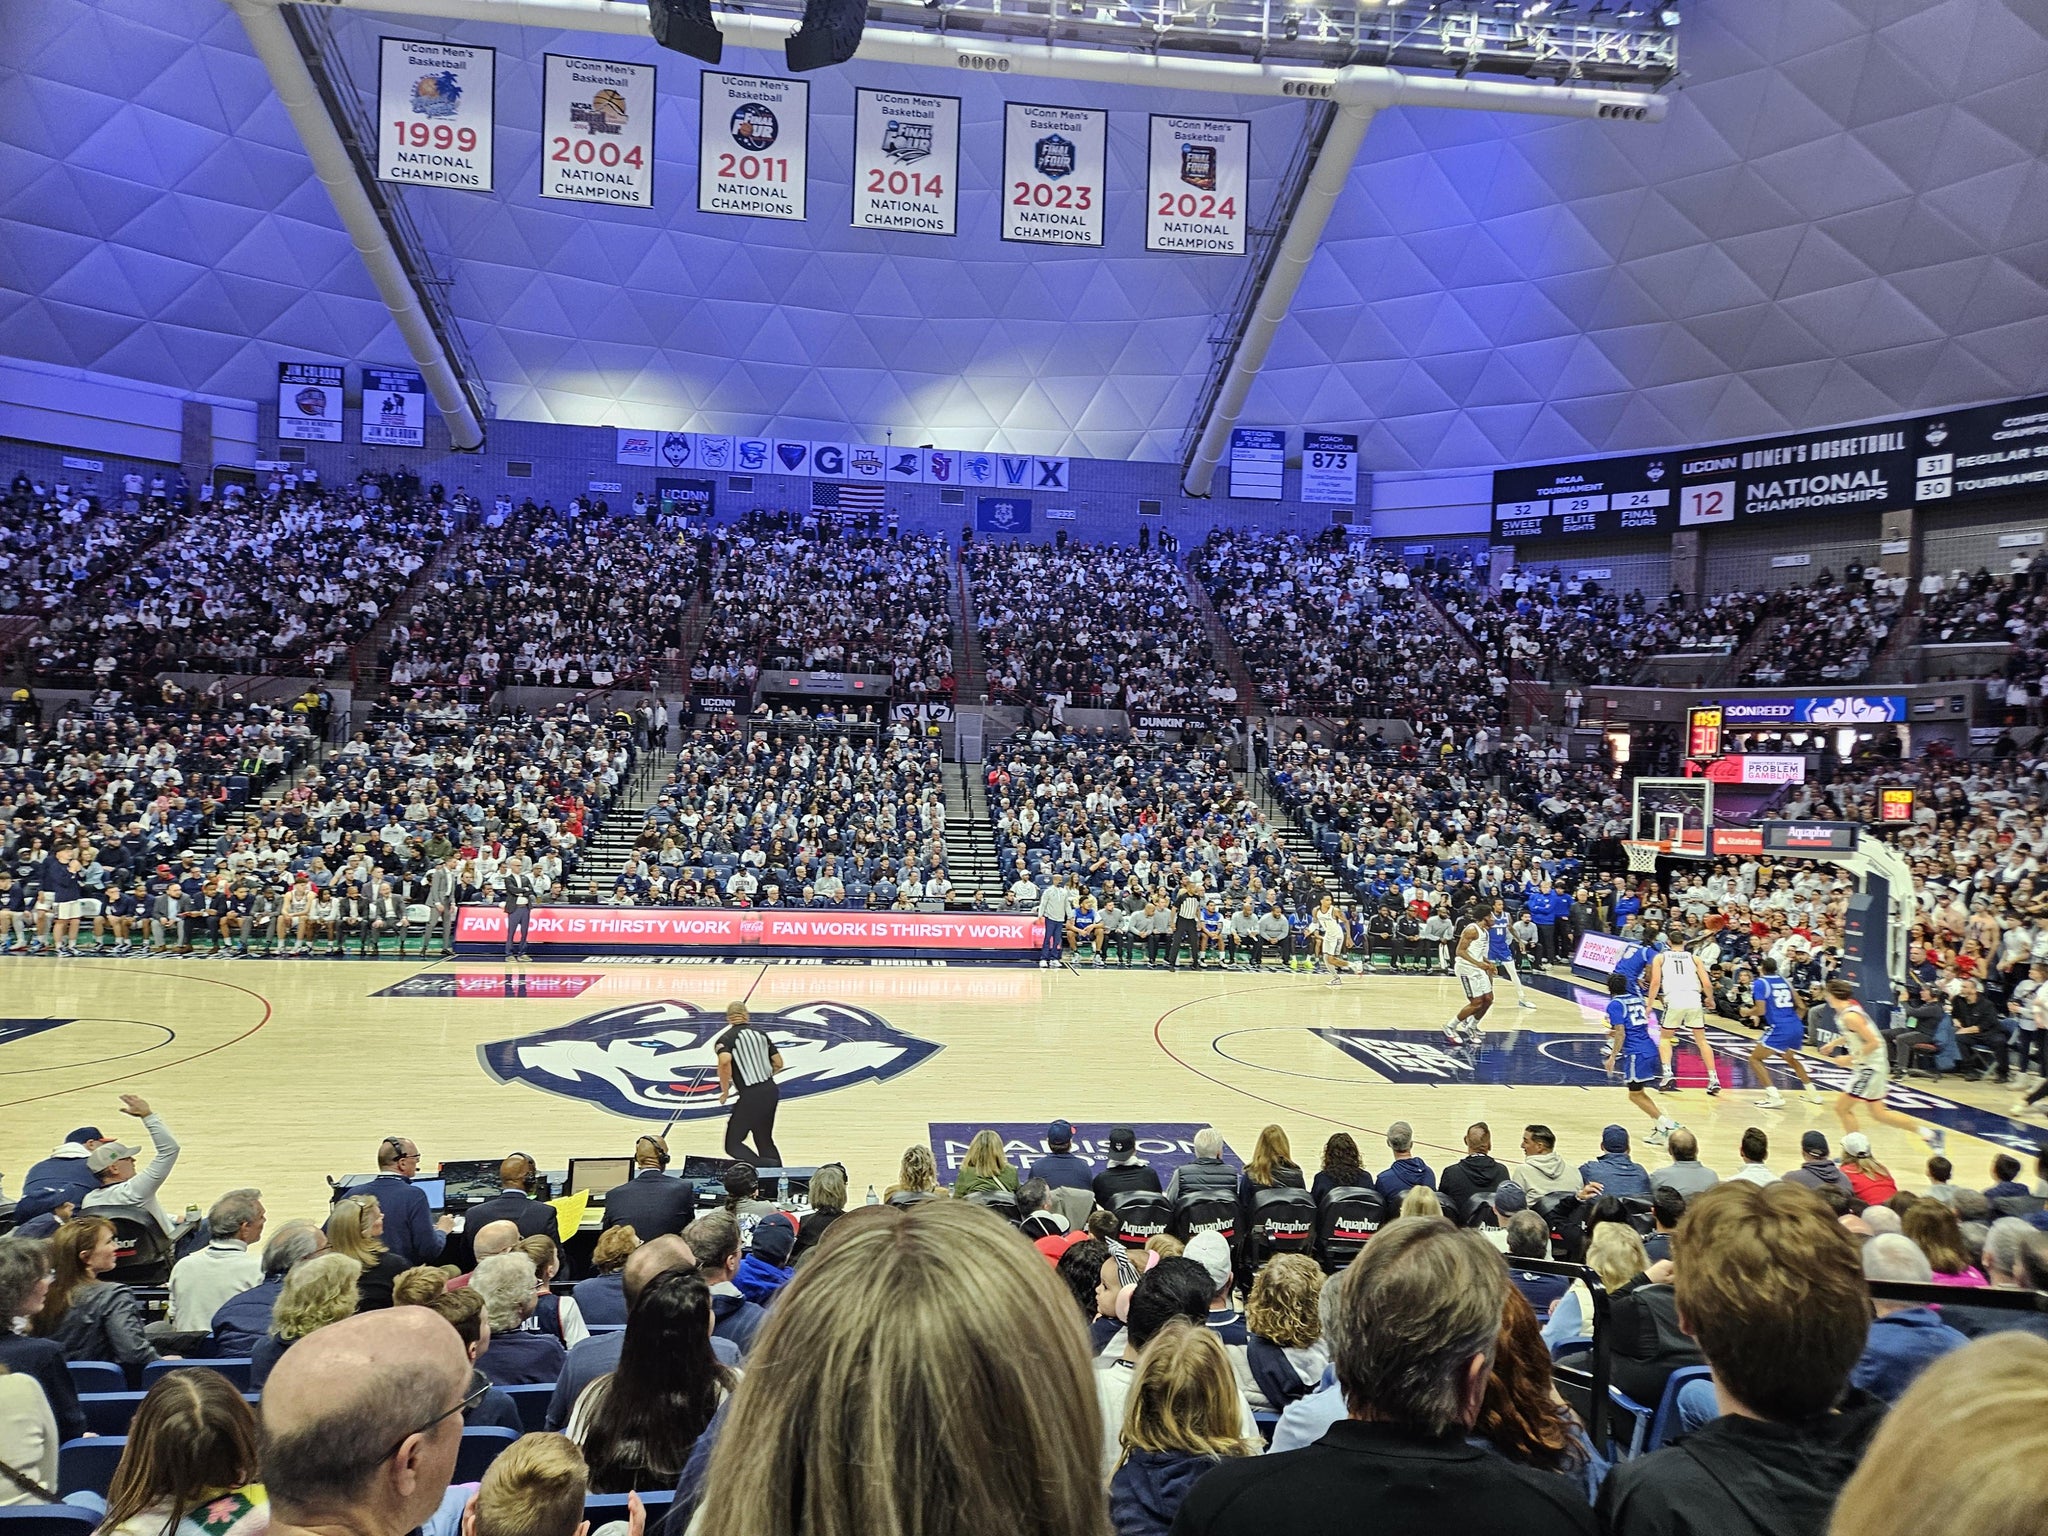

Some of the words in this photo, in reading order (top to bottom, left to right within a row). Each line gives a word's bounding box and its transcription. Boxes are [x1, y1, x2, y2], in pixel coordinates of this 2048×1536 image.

[402, 43, 439, 55] UConn
[443, 47, 474, 58] Men's
[409, 56, 466, 69] Basketball
[566, 60, 601, 71] UConn
[605, 64, 636, 75] Men's
[572, 73, 628, 87] Basketball
[722, 76, 757, 87] UConn
[760, 80, 789, 90] Men's
[729, 89, 782, 102] Basketball
[876, 94, 910, 104] UConn
[913, 97, 941, 107] Men's
[882, 106, 934, 118] Basketball
[1025, 108, 1057, 118] UConn
[1060, 111, 1088, 120] Men's
[1030, 120, 1081, 132] Basketball
[1169, 120, 1200, 130] UConn
[1204, 122, 1232, 132] Men's
[394, 121, 476, 152] 1999
[1174, 132, 1225, 143] Basketball
[398, 152, 473, 169] NATIONAL
[552, 136, 644, 170] 2004
[718, 153, 787, 182] 2011
[391, 167, 479, 185] CHAMPIONS
[562, 168, 633, 185] NATIONAL
[867, 168, 943, 198] 2014
[555, 183, 639, 201] CHAMPIONS
[718, 183, 787, 198] NATIONAL
[1013, 181, 1091, 210] 2023
[712, 198, 793, 214] CHAMPIONS
[871, 199, 938, 214] NATIONAL
[1158, 192, 1236, 220] 2024
[865, 213, 944, 229] CHAMPIONS
[1020, 212, 1086, 226] NATIONAL
[1014, 227, 1091, 241] CHAMPIONS
[1164, 222, 1229, 235] NATIONAL
[1158, 237, 1234, 250] CHAMPIONS
[2002, 412, 2048, 428] CONFE
[1318, 435, 1343, 443] COACH
[1992, 425, 2048, 441] CHAMPI
[626, 438, 648, 446] BIG
[1312, 452, 1347, 469] 873
[1681, 457, 1737, 475] UCONN
[1742, 445, 1807, 469] WOMEN'S
[1811, 431, 1906, 461] BASKETBALL
[1956, 448, 2031, 468] REGULAR
[2033, 446, 2048, 457] SE
[1926, 459, 1944, 472] 31
[1037, 460, 1065, 487] X
[1555, 475, 1584, 484] NCAA
[1536, 483, 1604, 496] TOURNAMENT
[1747, 468, 1888, 501] NATIONAL
[1922, 482, 1945, 495] 30
[661, 488, 709, 501] UCONN
[1631, 494, 1650, 506] 24
[1745, 487, 1888, 514] CHAMPIONSHIPS
[1514, 505, 1531, 515] 32
[1571, 500, 1589, 510] 29
[1692, 491, 1723, 516] 12
[1563, 514, 1595, 525] ELITE
[1621, 509, 1657, 520] FINAL
[1502, 519, 1542, 529] SWEET
[1562, 523, 1596, 532] EIGHTS
[1621, 518, 1657, 527] FOURS
[1502, 527, 1542, 536] SIXTEENS
[701, 698, 736, 707] UCONN
[1140, 717, 1186, 728] DUNKIN'
[1693, 727, 1718, 754] 30
[1749, 765, 1798, 773] PROBLEM
[1883, 803, 1906, 819] 30
[1788, 826, 1833, 840] Aquaphor
[463, 917, 500, 932] FAN
[505, 918, 563, 933] ORK
[568, 919, 585, 932] IS
[590, 919, 669, 933] THIRSTY
[672, 920, 731, 934] WORK
[772, 921, 807, 935] FAN
[811, 922, 866, 936] WORK
[871, 923, 887, 936] IS
[890, 923, 965, 937] THIRSTY
[968, 925, 1023, 938] WORK
[582, 956, 725, 964] BASKETBALL
[1674, 960, 1684, 975] 11
[1771, 989, 1793, 1008] 22
[1628, 1004, 1647, 1026] 23
[1120, 1220, 1167, 1235] Aquaphor
[1189, 1217, 1236, 1234] Aquaphor
[1265, 1218, 1312, 1233] Aquaphor
[1335, 1217, 1379, 1234] Aquaphor
